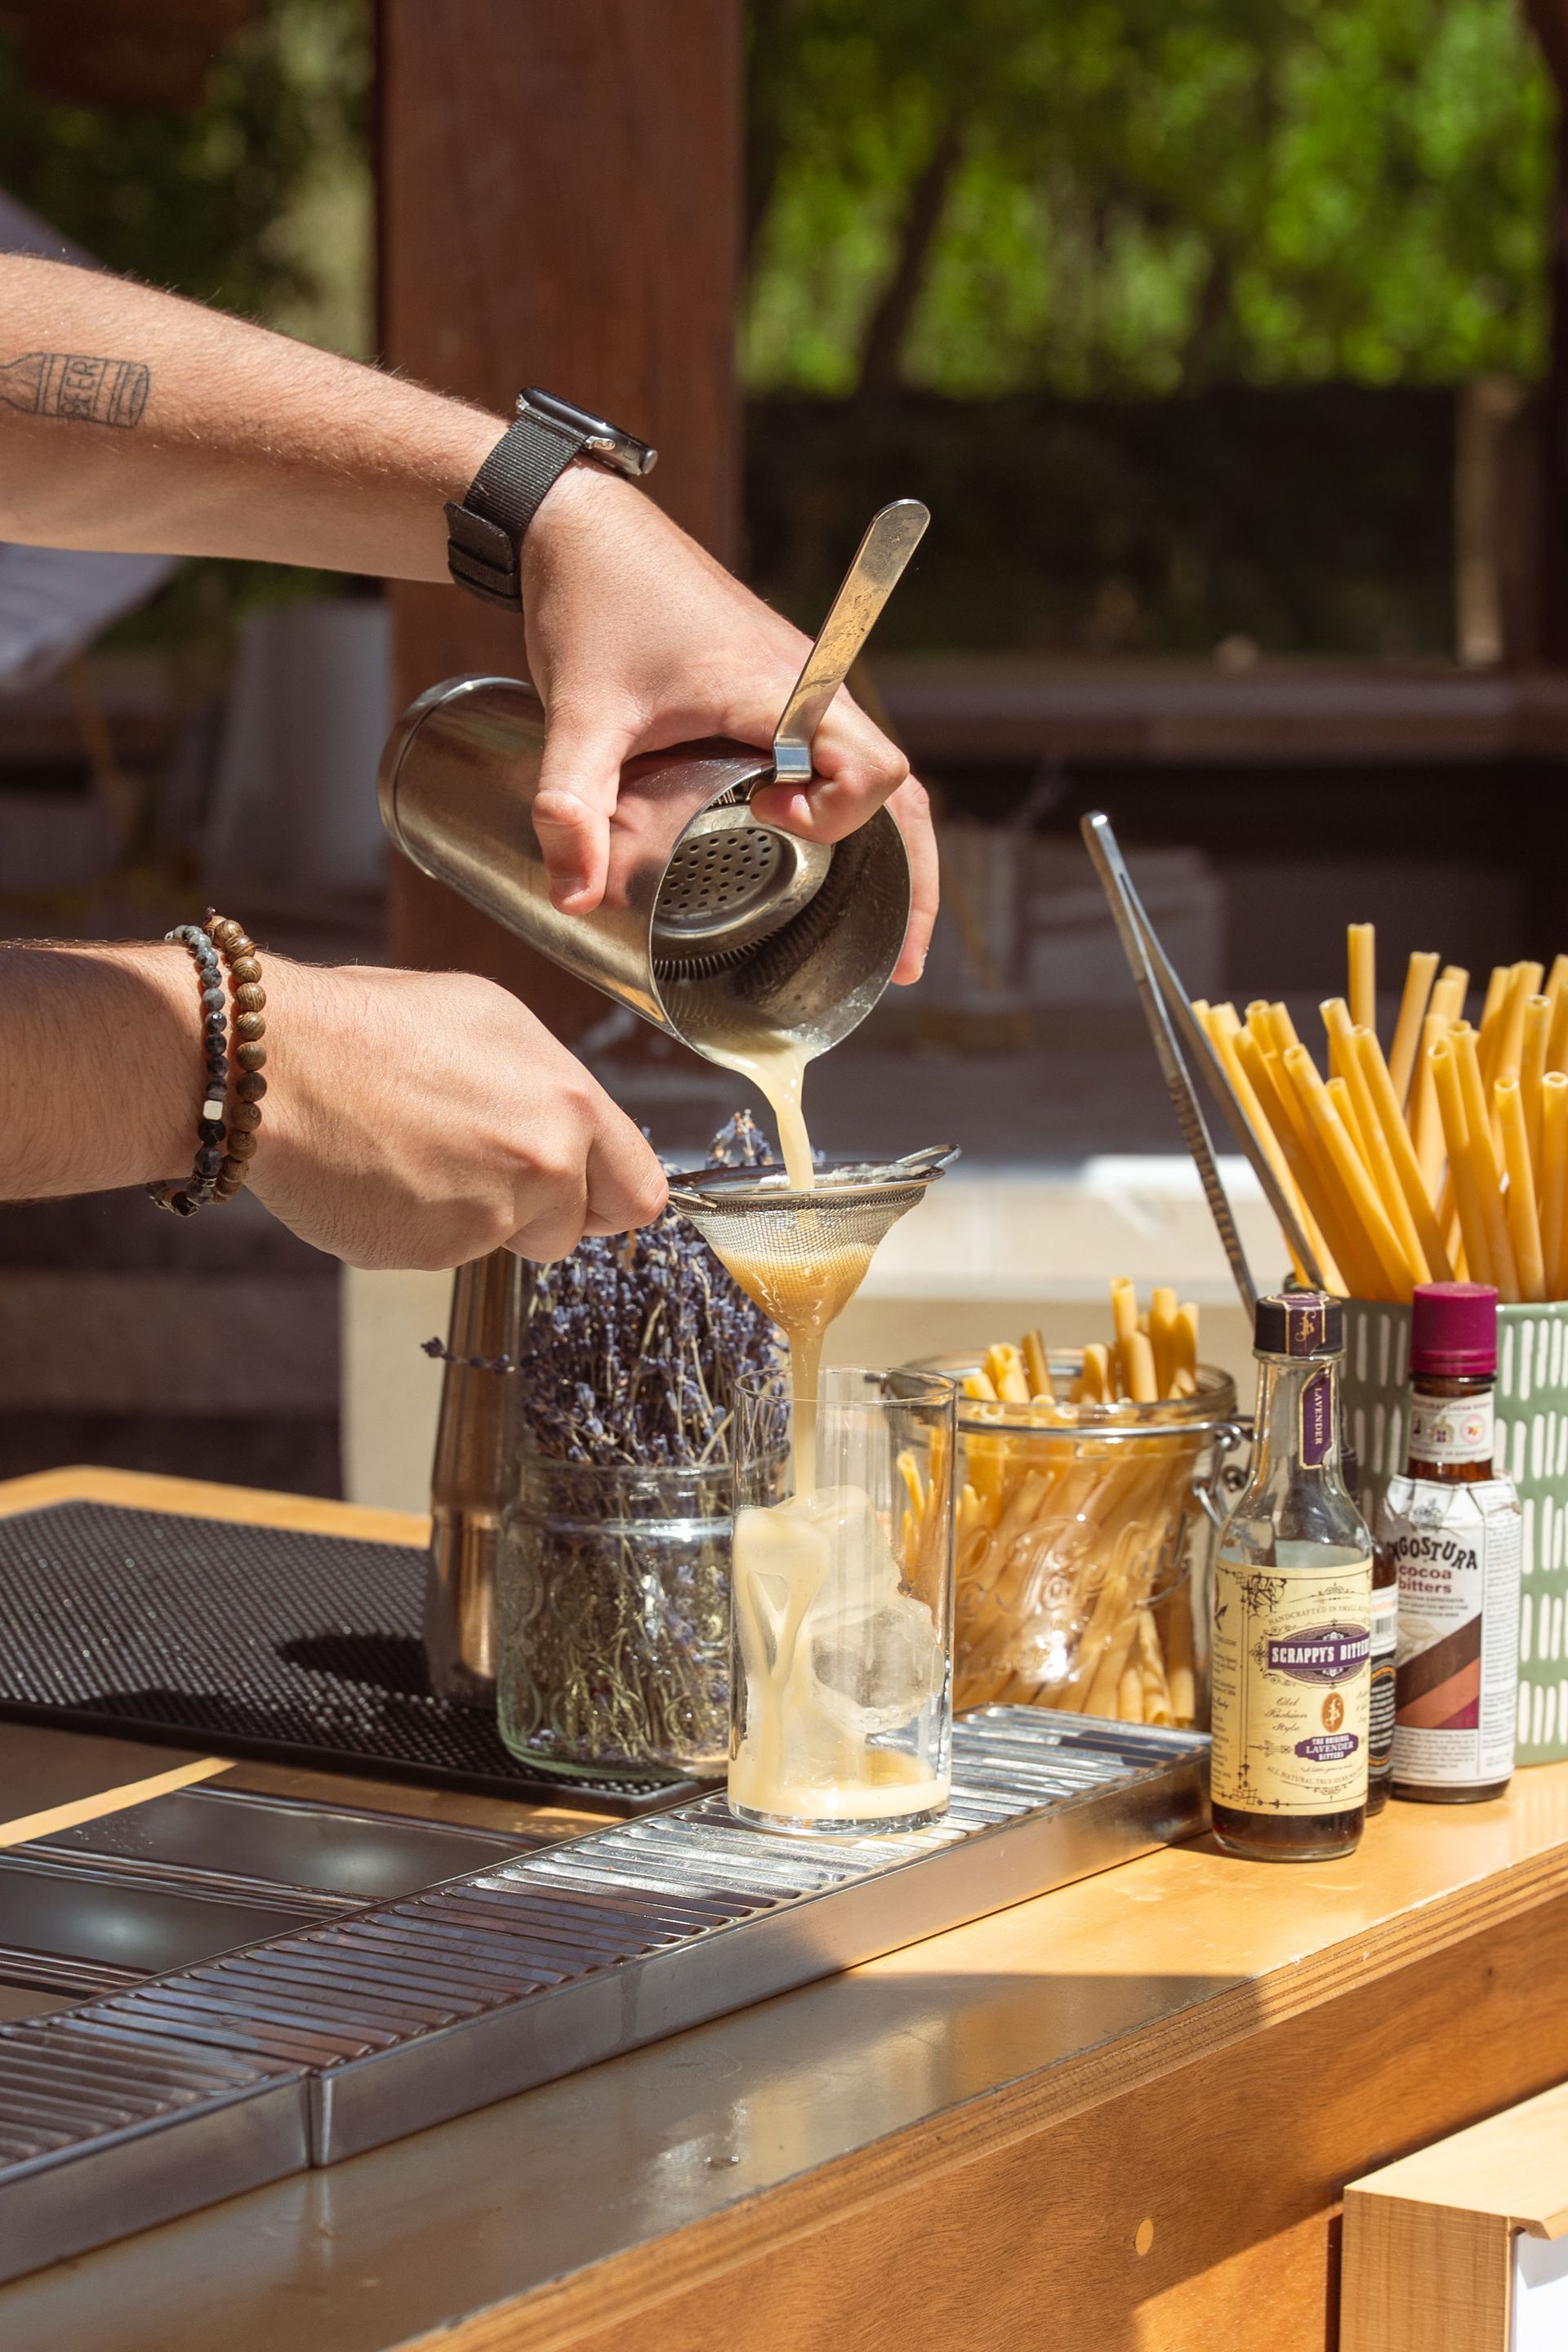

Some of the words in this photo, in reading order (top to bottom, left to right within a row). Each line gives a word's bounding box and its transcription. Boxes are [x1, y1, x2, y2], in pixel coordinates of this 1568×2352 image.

[61, 358, 100, 419] BEER
[1313, 1388, 1324, 1446] LAVENDER
[1387, 1536, 1477, 1570] NGOSTURA
[1398, 1565, 1452, 1579] cocoa
[1398, 1577, 1452, 1593] bitters
[1269, 1606, 1327, 1625] HANDCRAFTED
[1272, 1646, 1335, 1664] SCRAPPY'S
[1306, 1740, 1354, 1754] LAVENDER
